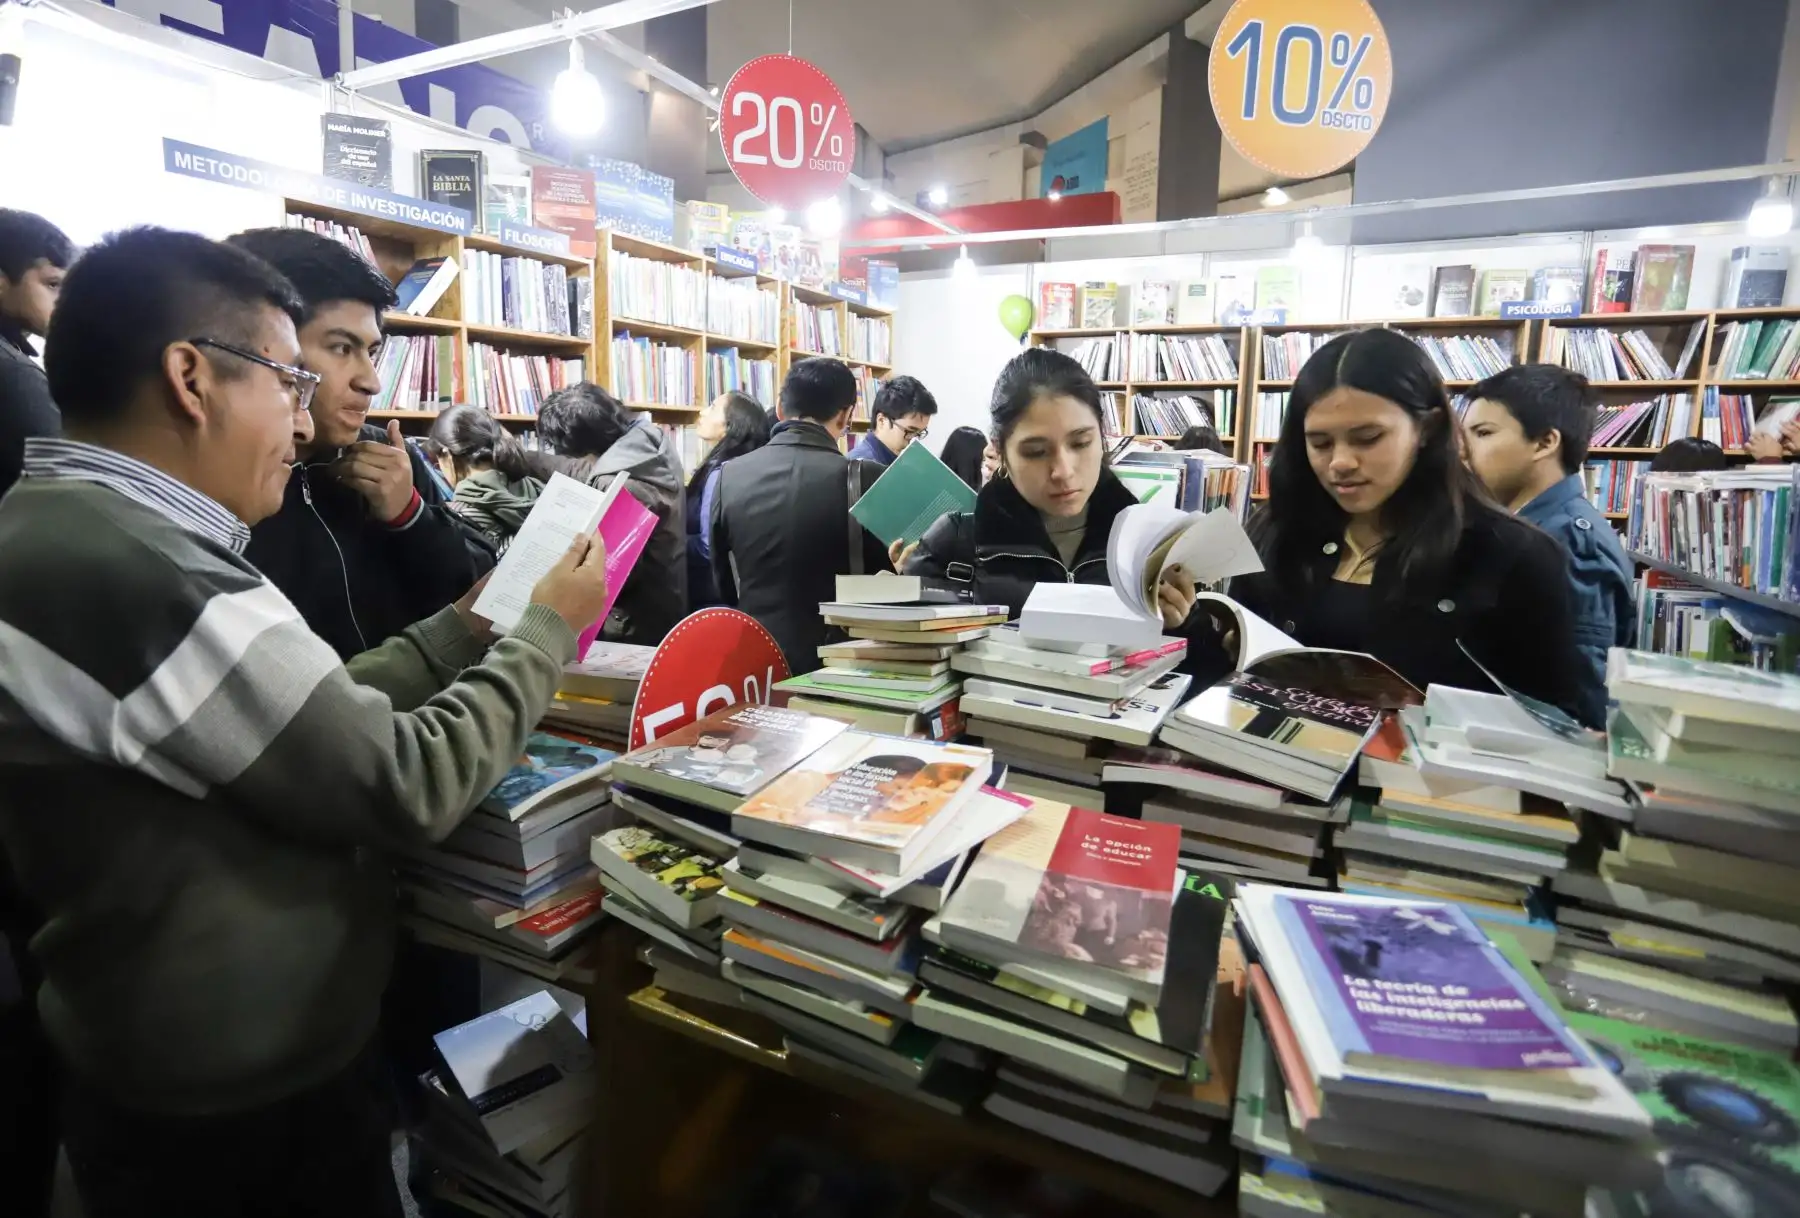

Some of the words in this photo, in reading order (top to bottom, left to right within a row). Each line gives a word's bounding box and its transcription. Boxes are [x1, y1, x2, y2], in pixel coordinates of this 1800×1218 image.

[1225, 18, 1373, 127] 10%
[732, 91, 843, 169] 20%
[1320, 110, 1373, 131] DSCTO
[433, 182, 472, 192] BIBLIA
[326, 187, 346, 206] DE
[350, 191, 466, 231] INVESTIGACIÓN
[1081, 842, 1098, 851] de
[1103, 847, 1152, 860] educar
[1085, 833, 1100, 843] La
[1105, 839, 1152, 852] opción
[1441, 985, 1469, 996] de
